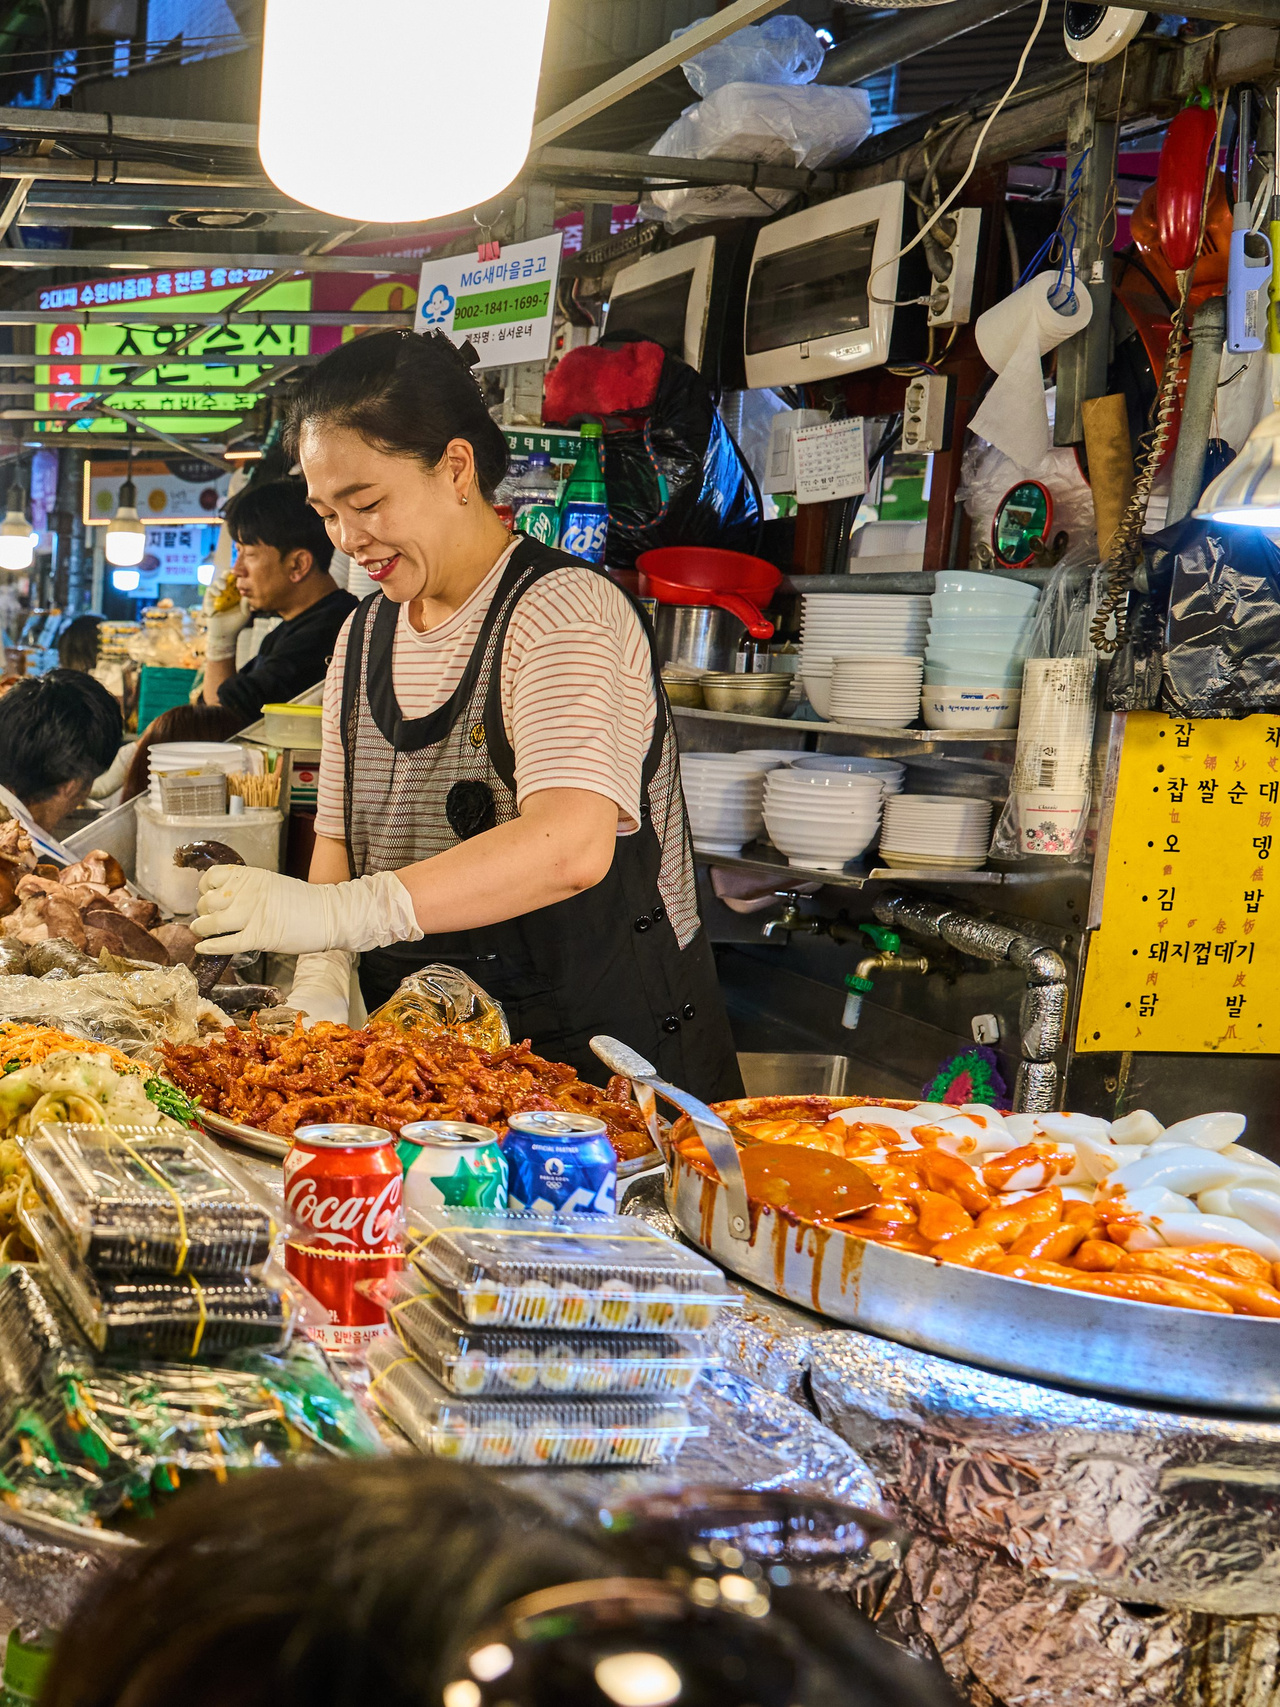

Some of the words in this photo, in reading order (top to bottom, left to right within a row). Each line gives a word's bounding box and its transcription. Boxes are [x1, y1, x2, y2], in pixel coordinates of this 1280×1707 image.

[460, 256, 547, 288] MG새마을금고
[39, 286, 78, 310] 2대째
[80, 276, 154, 305] 수원아줌마
[155, 273, 173, 295] 죽
[174, 269, 206, 293] 전문
[454, 291, 550, 321] 9002-1841-1699-7
[497, 323, 533, 342] 심서운녀
[1147, 940, 1256, 966] 돼지껍데기
[531, 1143, 555, 1152] OFFICIAL
[555, 1145, 580, 1154] PARTNER
